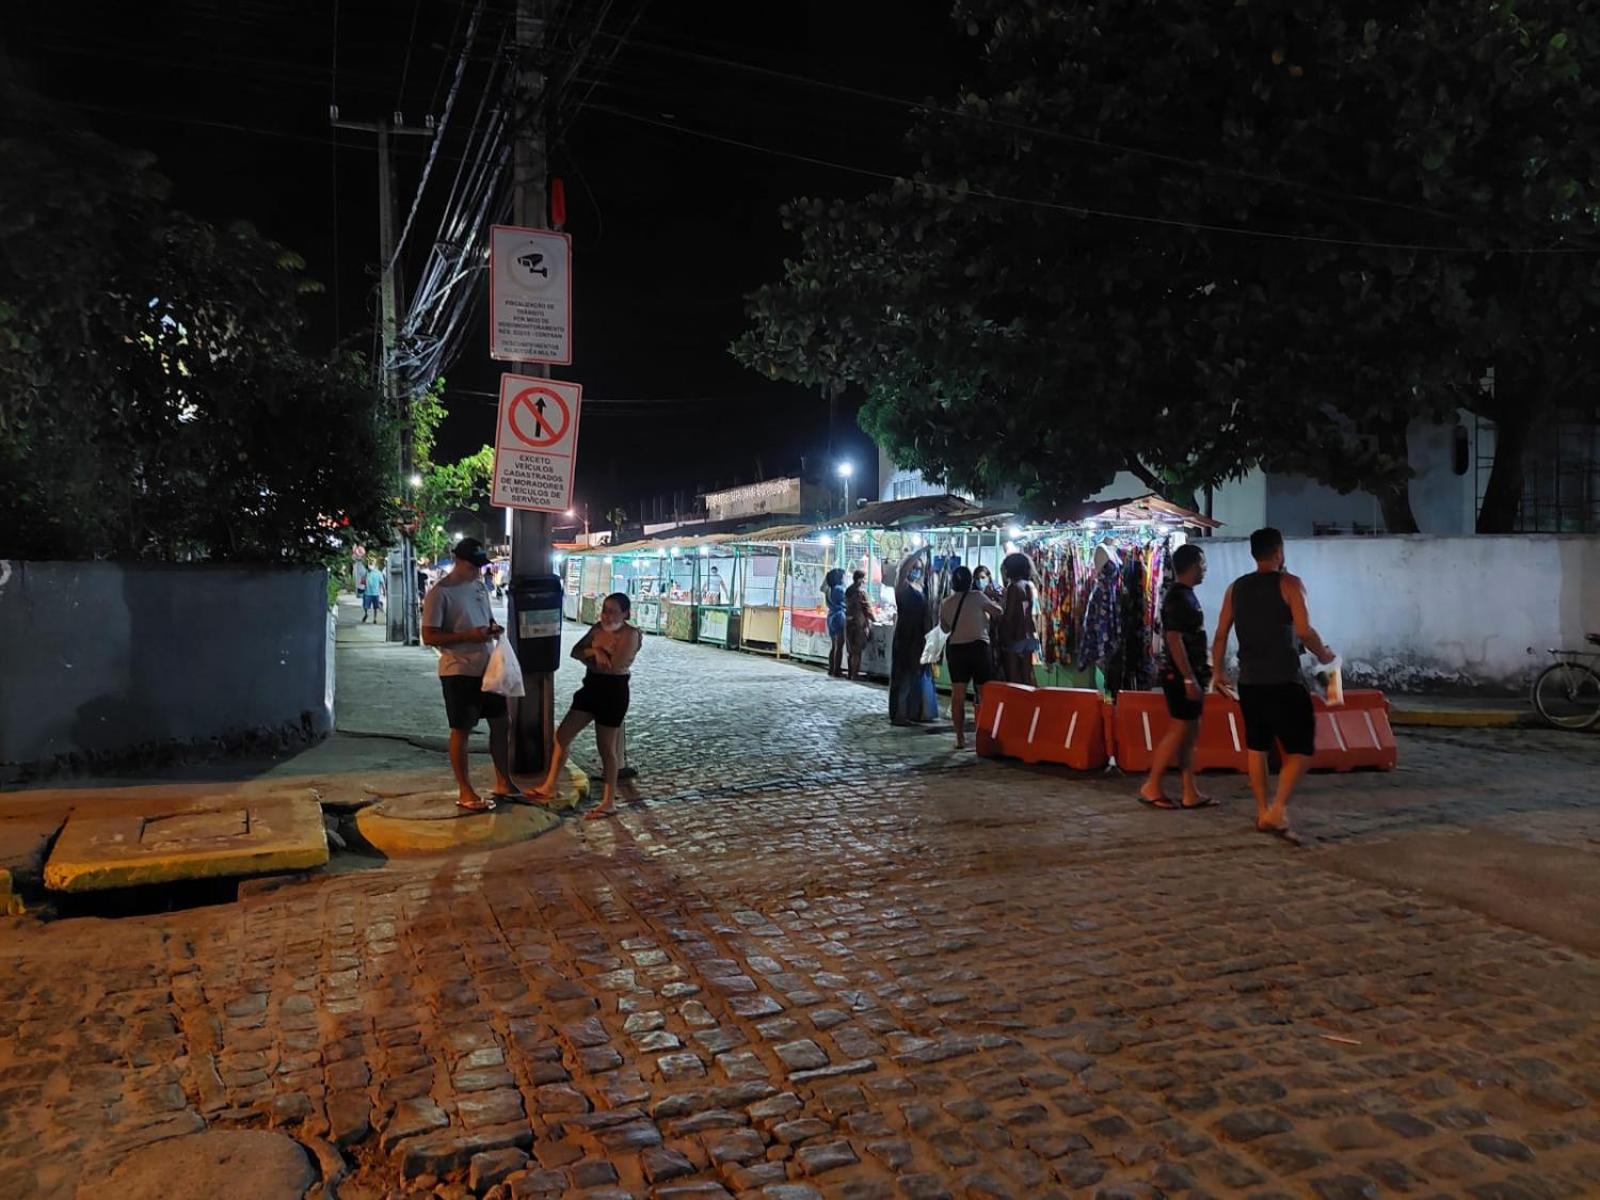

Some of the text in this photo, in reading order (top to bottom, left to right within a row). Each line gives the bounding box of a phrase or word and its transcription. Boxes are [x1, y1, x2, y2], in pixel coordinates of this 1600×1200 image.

[520, 454, 550, 464] EXCETO
[504, 469, 563, 482] CADASTRADOS
[514, 479, 563, 491] MORADORES
[512, 495, 551, 505] SERVIÇOS
